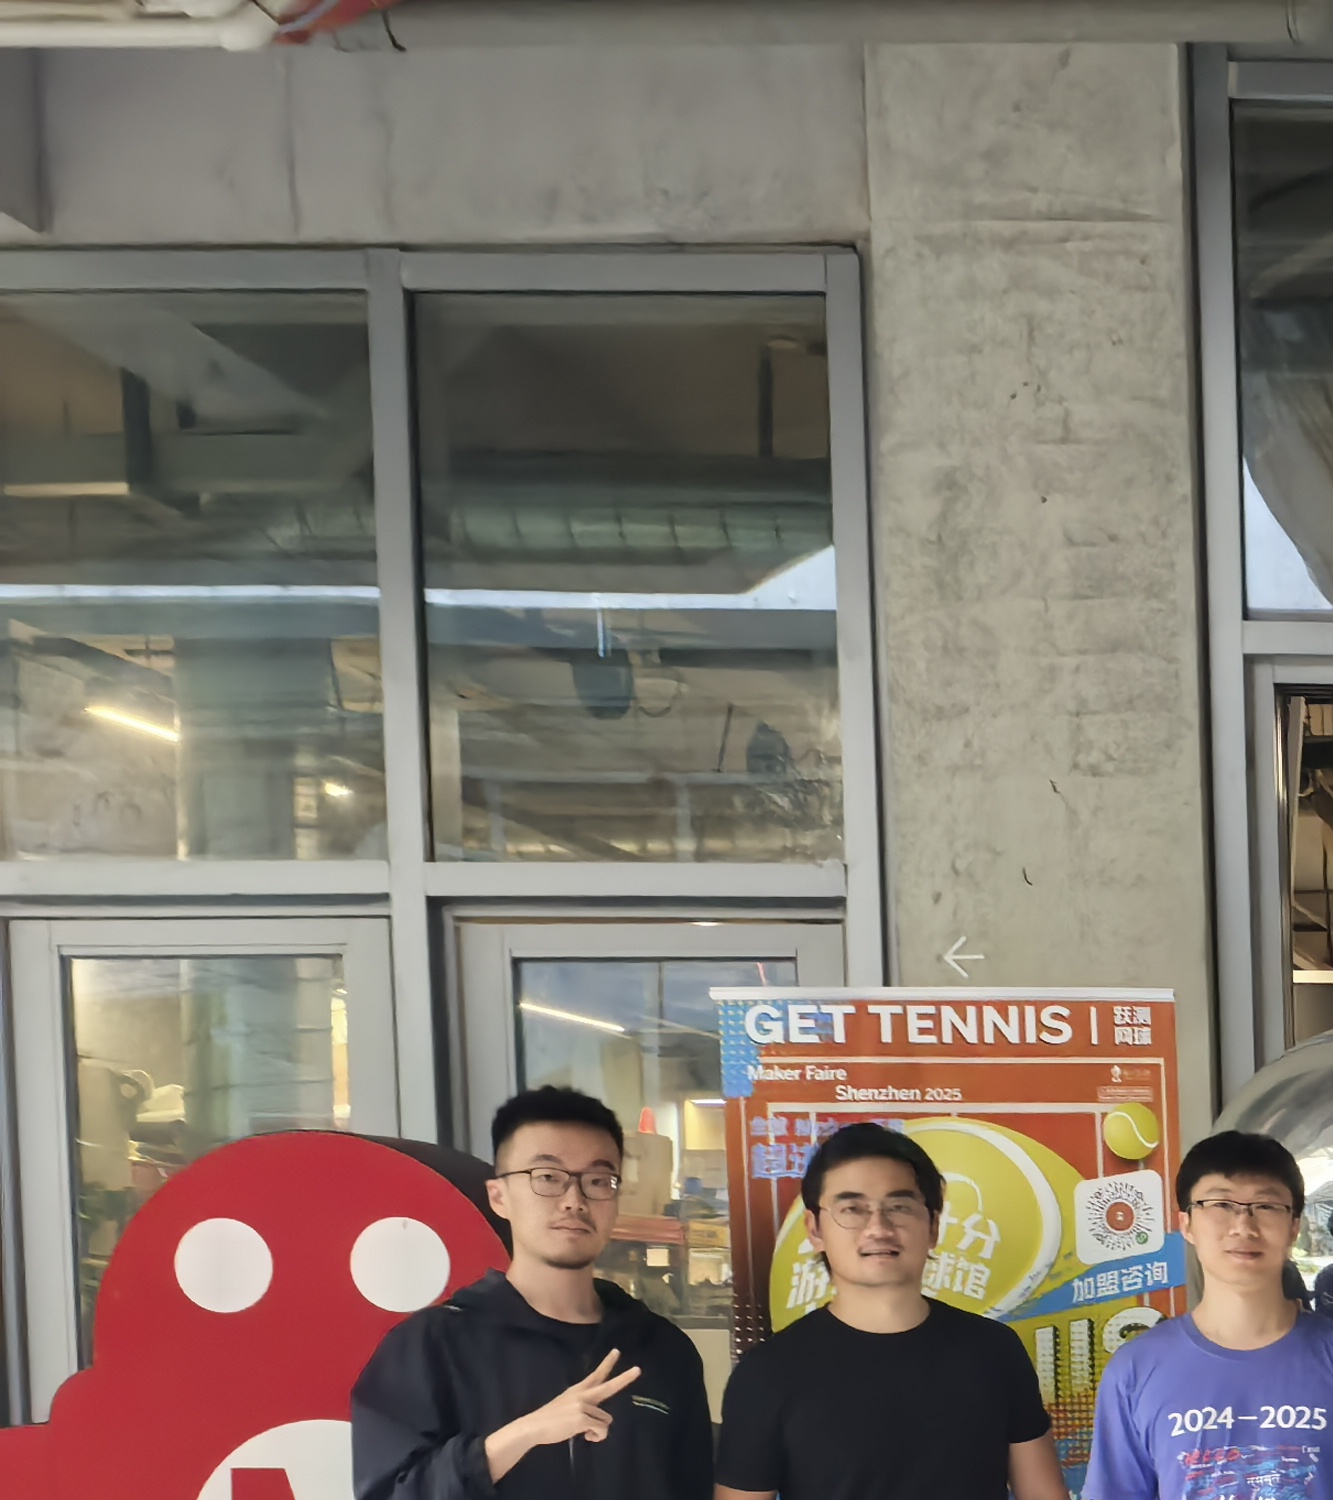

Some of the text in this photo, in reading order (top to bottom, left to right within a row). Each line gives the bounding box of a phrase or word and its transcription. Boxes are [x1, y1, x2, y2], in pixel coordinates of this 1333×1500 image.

[744, 1004, 1073, 1045] GET TENNIS
[747, 1065, 847, 1081] Maker Faire
[835, 1085, 963, 1101] Shenzhen 2025
[1072, 1261, 1169, 1303] 加盟咨询
